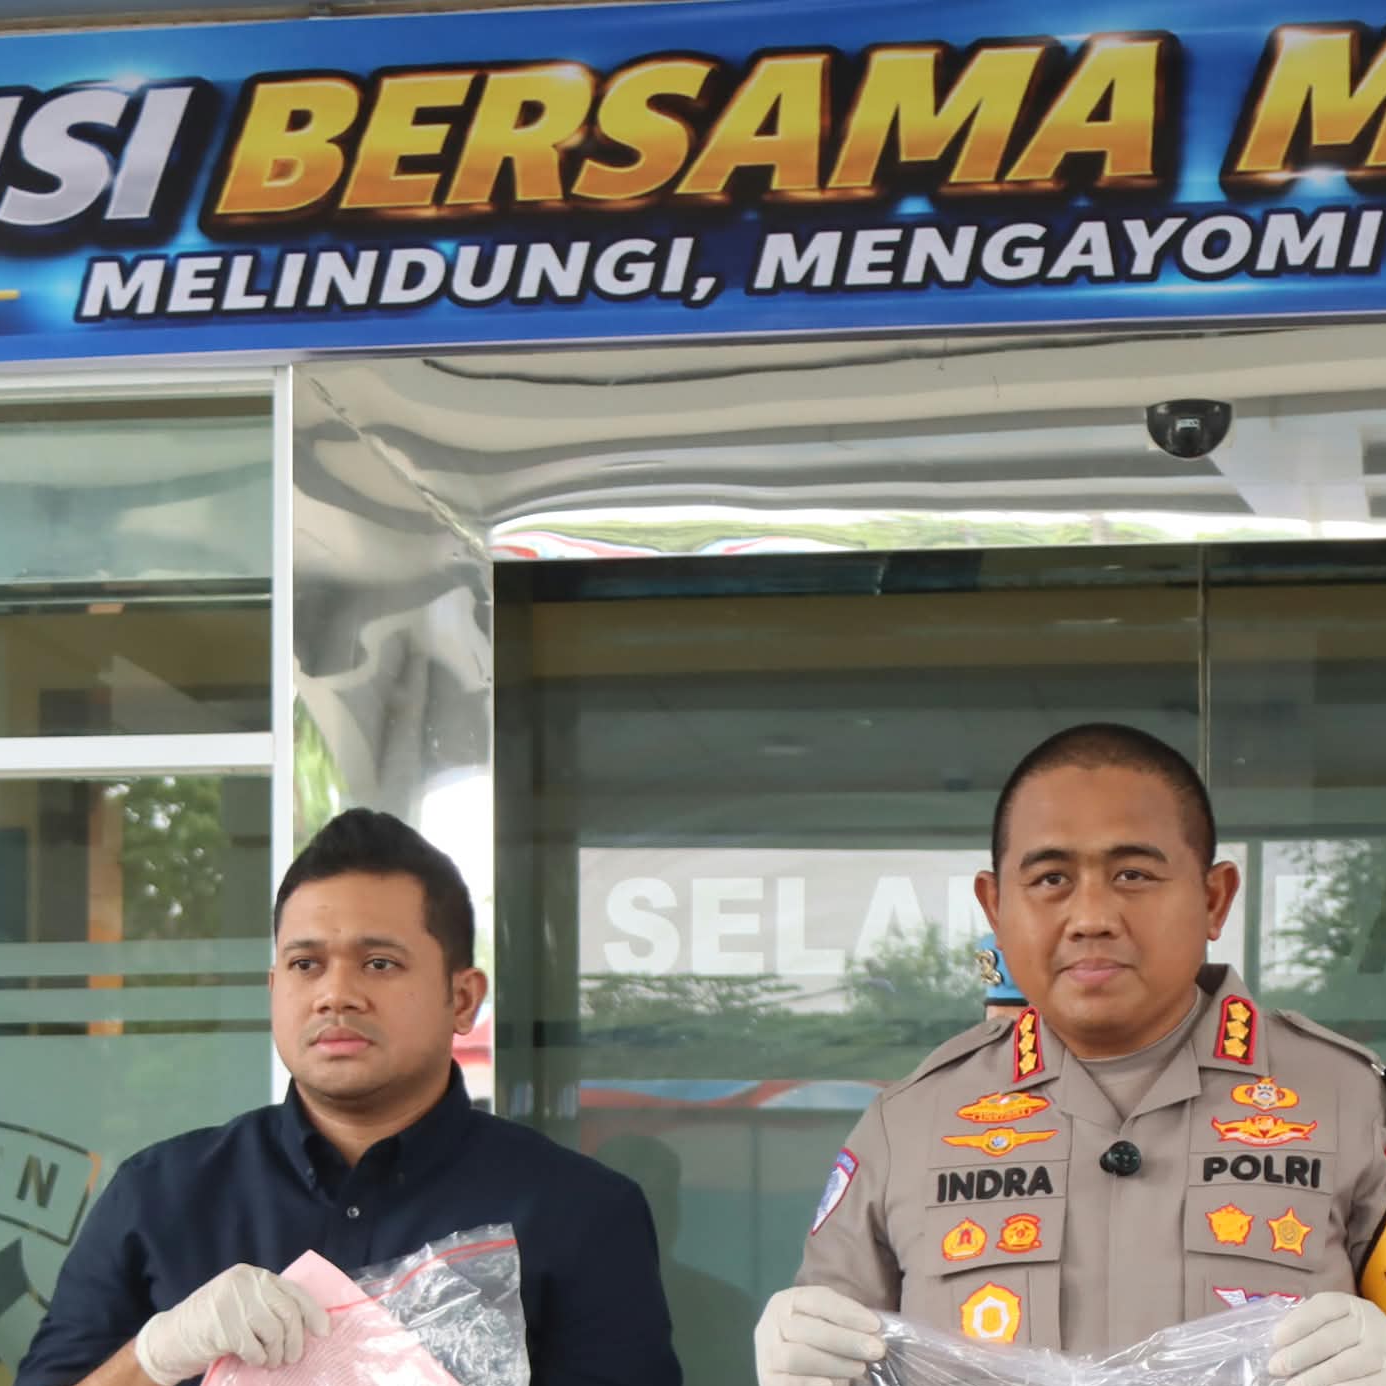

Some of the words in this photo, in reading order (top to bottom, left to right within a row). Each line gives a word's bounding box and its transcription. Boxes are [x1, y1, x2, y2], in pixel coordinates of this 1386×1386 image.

[215, 34, 1159, 216] BERSAMA
[80, 235, 717, 320] MELINDUNGI,
[753, 207, 1381, 289] MENGAYOMI
[603, 875, 991, 977] SELA
[938, 1166, 1053, 1202] INDRA
[1203, 1154, 1322, 1188] POLRI
